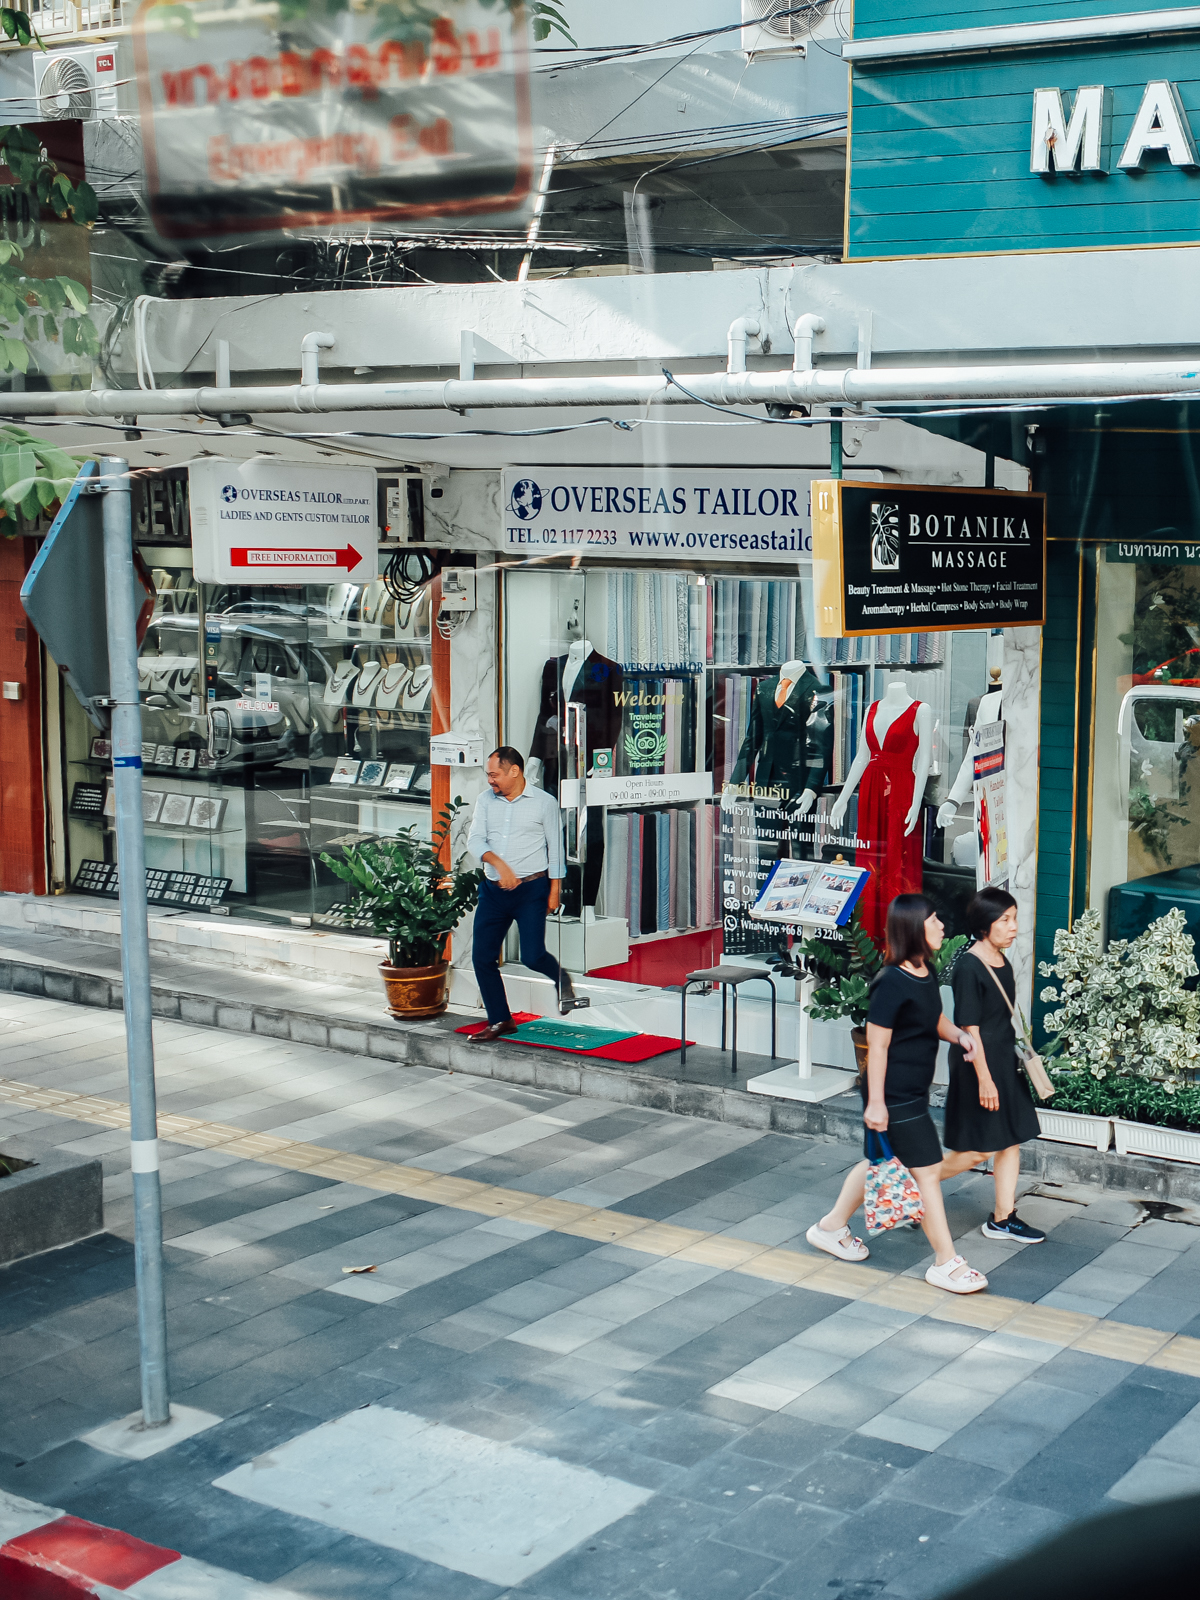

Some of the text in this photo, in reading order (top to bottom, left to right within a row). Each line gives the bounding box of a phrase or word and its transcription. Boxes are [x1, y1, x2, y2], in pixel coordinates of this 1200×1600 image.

[97, 59, 112, 67] TCL
[241, 489, 301, 502] OVERSEAS
[302, 491, 343, 504] TAILOR
[551, 486, 687, 514] OVERSEAS
[693, 488, 800, 517] TAILOR
[220, 510, 371, 524] LADIES AND GENTS CUSTOM TAILOR
[908, 514, 1031, 539] BOTANIKA
[506, 527, 540, 544] TEL.
[541, 528, 557, 544] 02
[560, 529, 584, 544] 117
[586, 530, 618, 545] 2233
[251, 552, 335, 562] FREE INFORMATION
[931, 550, 1007, 568] MASSAGE
[848, 581, 1038, 596] Beauty Treatment & Massage Hot Stone Therapy Facial Treatment
[861, 600, 1029, 616] Aromatherapy Herbal Compress Body Scrub Body Wrap
[206, 626, 220, 634] VISA
[616, 661, 704, 676] OVERSEAS TAILOR
[613, 690, 685, 708] Welcome
[236, 701, 279, 712] WELCOME
[628, 712, 666, 721] Travelers'
[632, 721, 661, 729] Choice
[628, 760, 666, 769] Tripadvisor
[625, 779, 665, 790] Open Hours
[609, 790, 629, 800] 09:00
[648, 788, 667, 798] 09:00
[668, 789, 680, 799] pm
[723, 853, 745, 863] Please
[745, 855, 760, 866] visit
[740, 919, 780, 936] WhatsApp
[780, 925, 796, 936] +66
